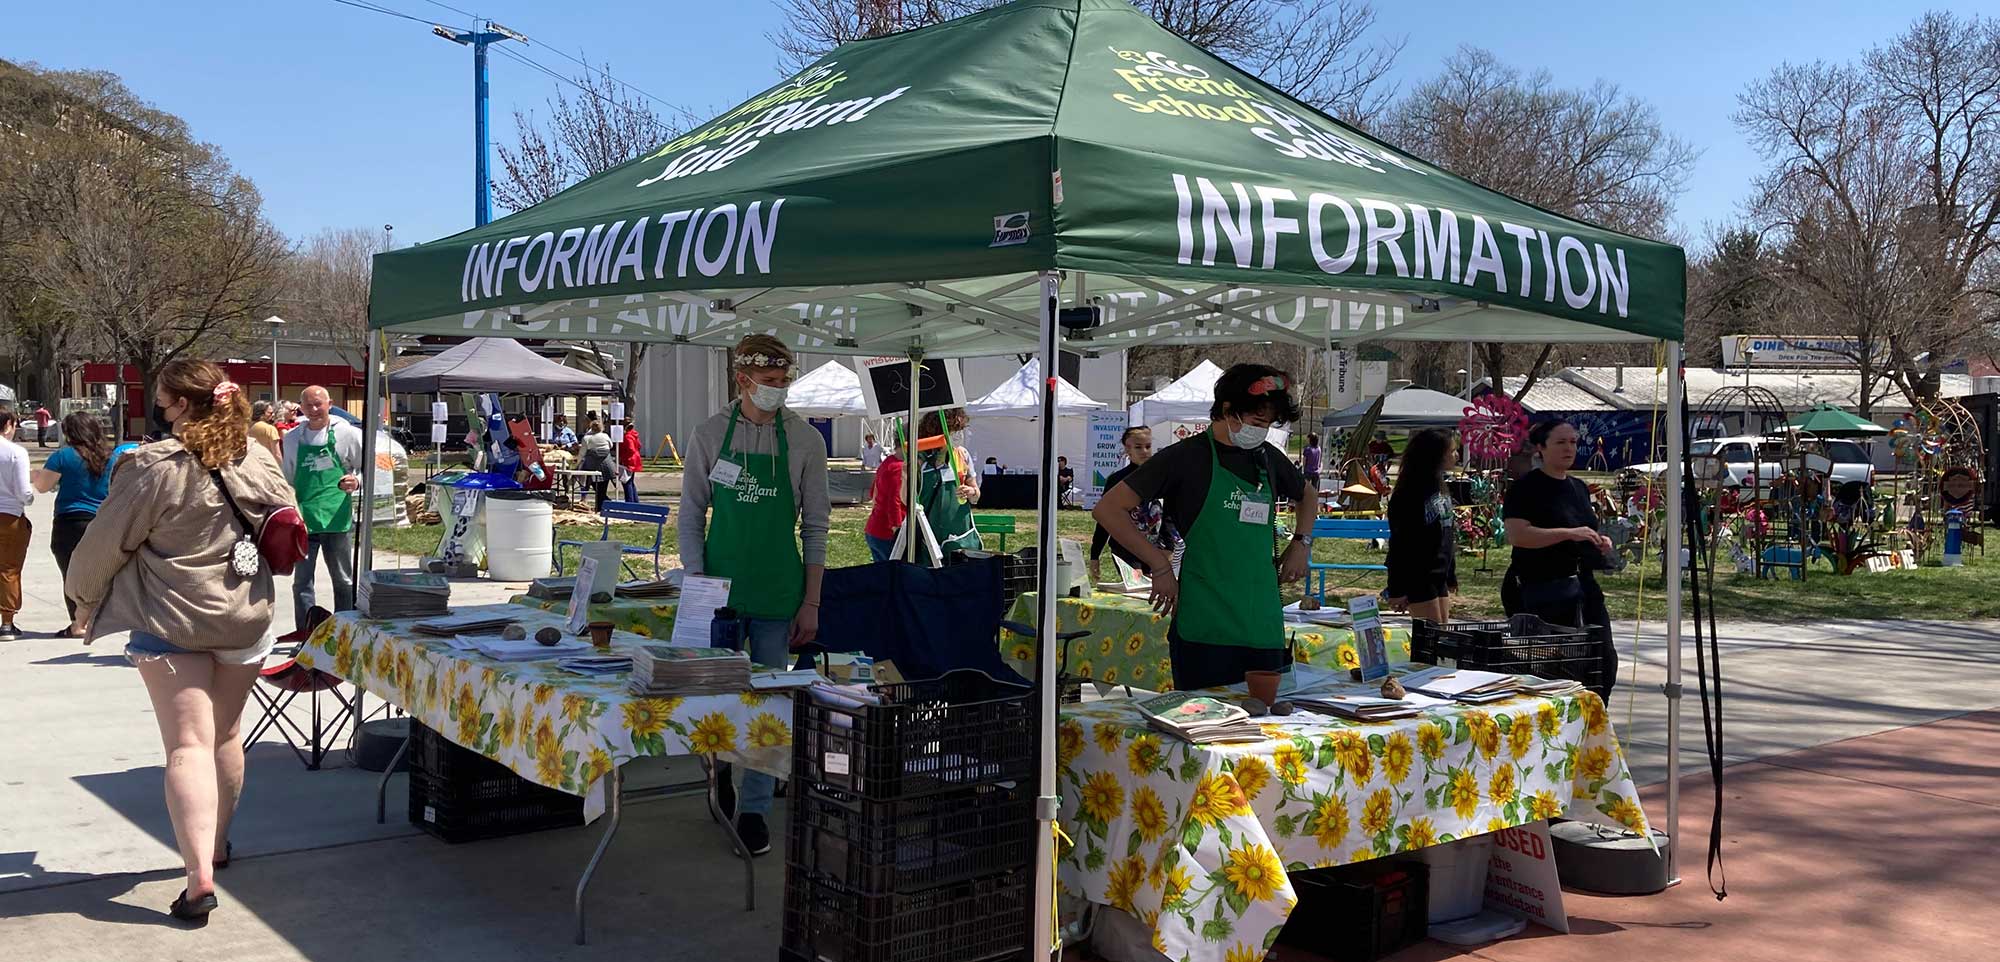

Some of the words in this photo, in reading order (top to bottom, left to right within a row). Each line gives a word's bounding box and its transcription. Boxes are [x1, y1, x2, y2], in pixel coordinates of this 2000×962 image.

[720, 85, 912, 145] Plant
[1113, 93, 1273, 125] School
[636, 139, 761, 188] Sale
[1250, 127, 1387, 174] Sale
[461, 197, 786, 302] INFORMATION
[1171, 172, 1630, 319] INFORMATION
[1753, 341, 1785, 351] DINE
[1096, 442, 1117, 450] GROW
[736, 491, 760, 504] Sale
[747, 484, 778, 497] Plant
